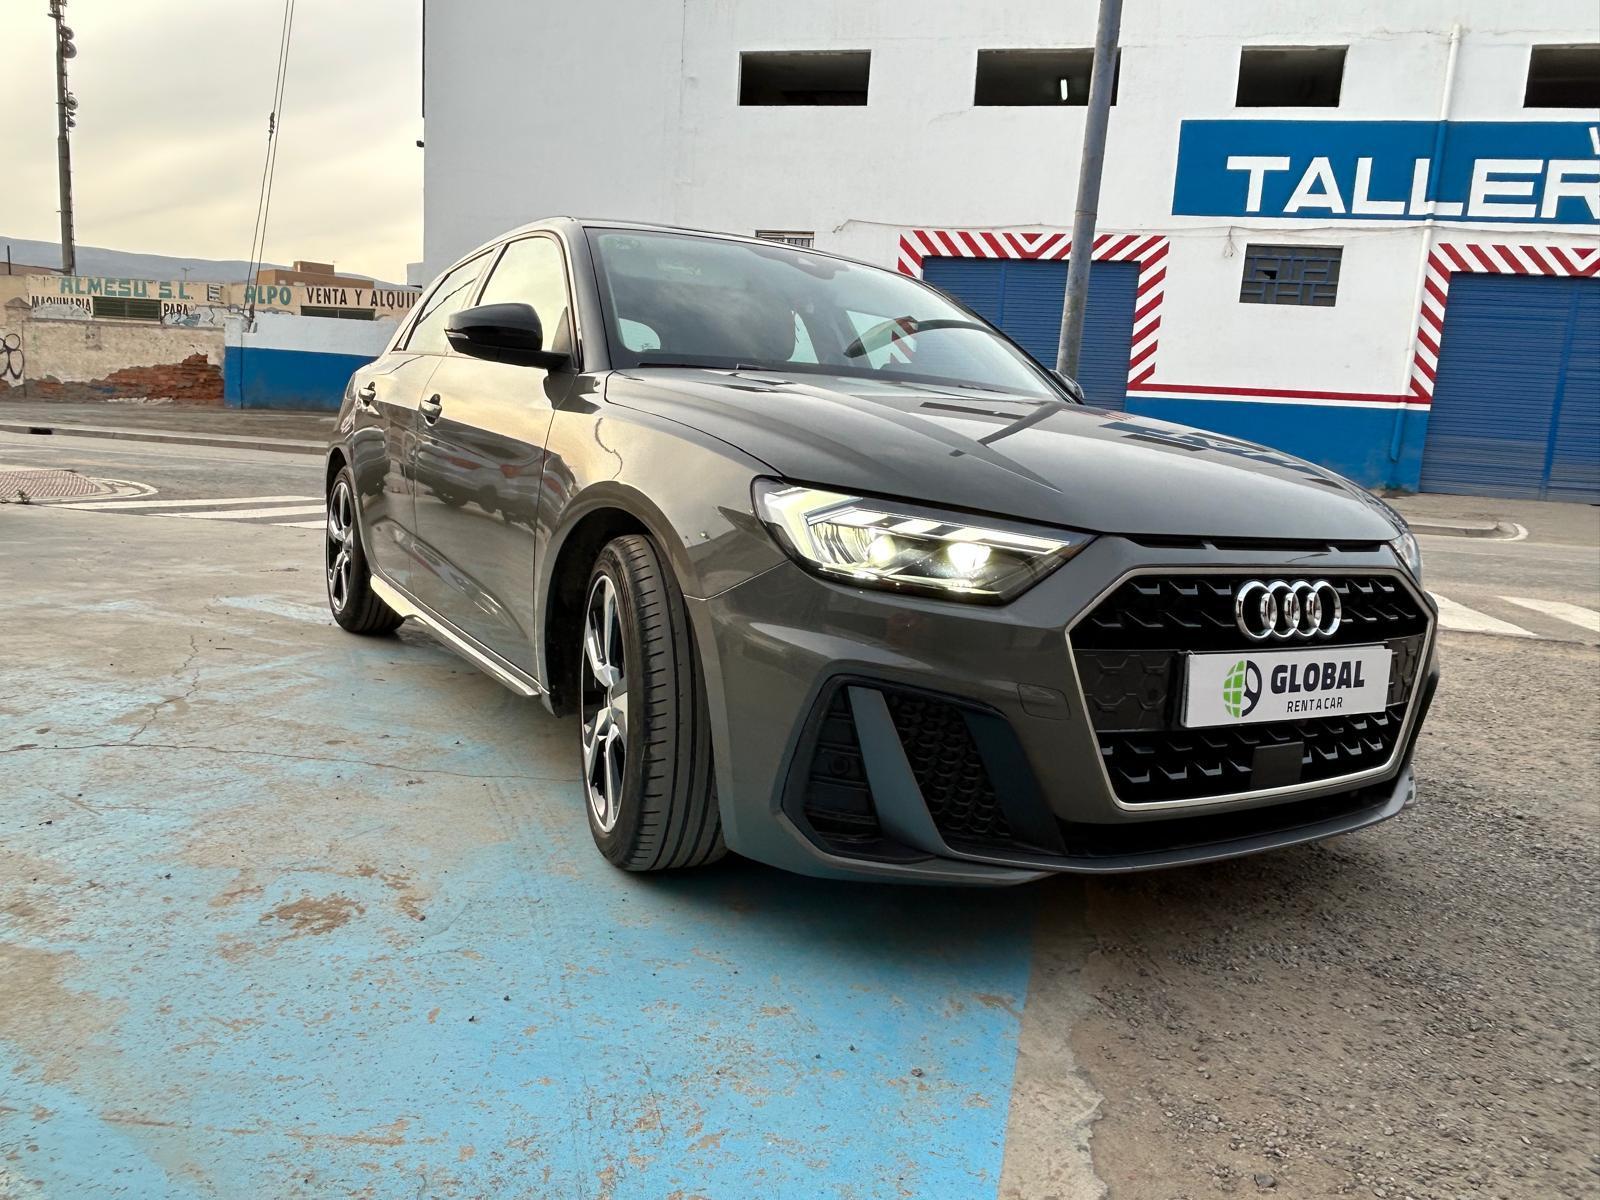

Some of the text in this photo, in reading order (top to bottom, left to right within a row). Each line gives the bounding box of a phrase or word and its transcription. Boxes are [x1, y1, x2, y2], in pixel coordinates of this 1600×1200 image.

[1226, 156, 1600, 219] TALLER
[60, 276, 194, 300] ALMESU S.L.
[245, 286, 292, 305] ALPO
[306, 287, 422, 310] VENTA Y ALQUIL
[164, 303, 189, 317] PARA
[1271, 660, 1365, 694] GLOBAL
